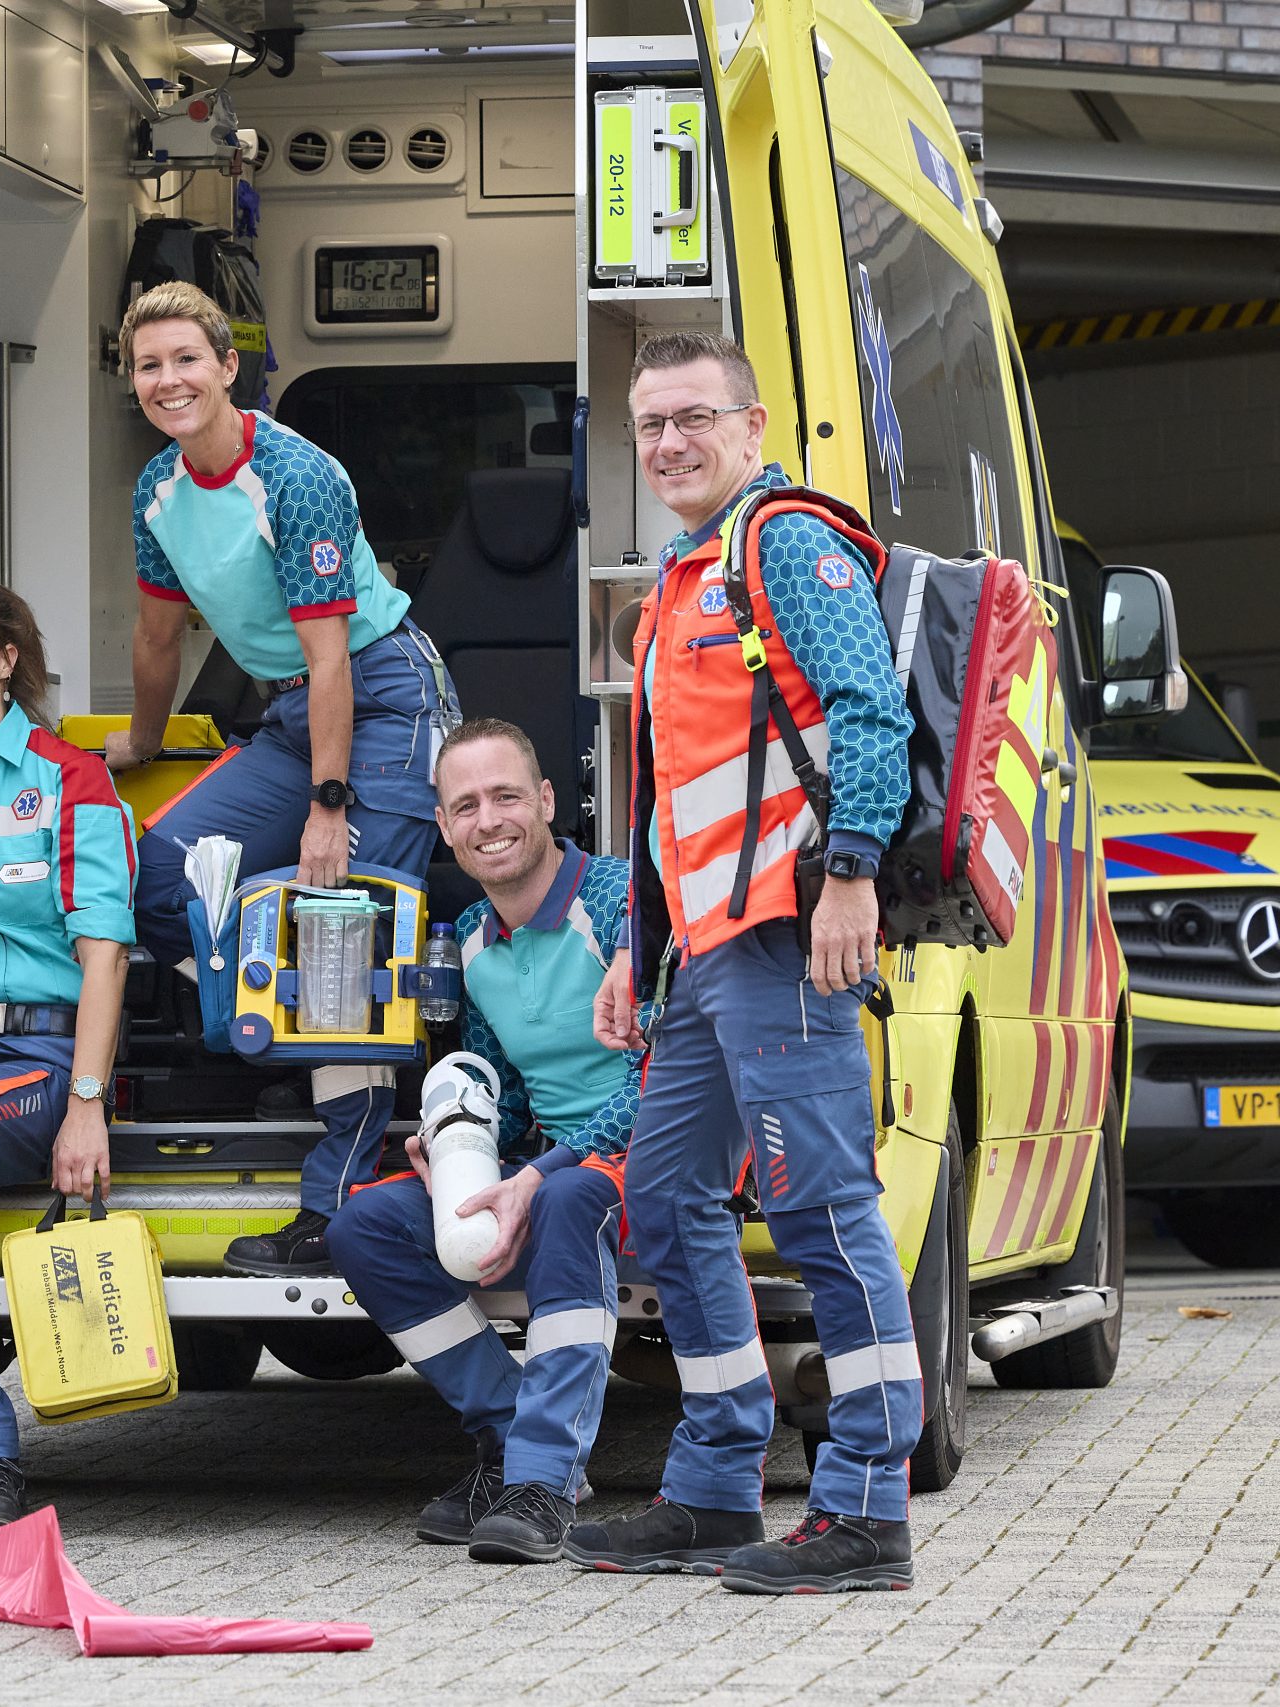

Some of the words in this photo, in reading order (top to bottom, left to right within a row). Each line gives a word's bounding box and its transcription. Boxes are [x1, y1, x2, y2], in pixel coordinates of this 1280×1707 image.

[609, 154, 625, 216] 20-112
[343, 261, 407, 291] 16:22
[397, 901, 416, 910] LSU
[51, 1246, 83, 1304] RAV
[96, 1251, 128, 1355] Medicatie
[41, 1263, 52, 1297] Brabant
[47, 1297, 70, 1384] Midden-West-Noord
